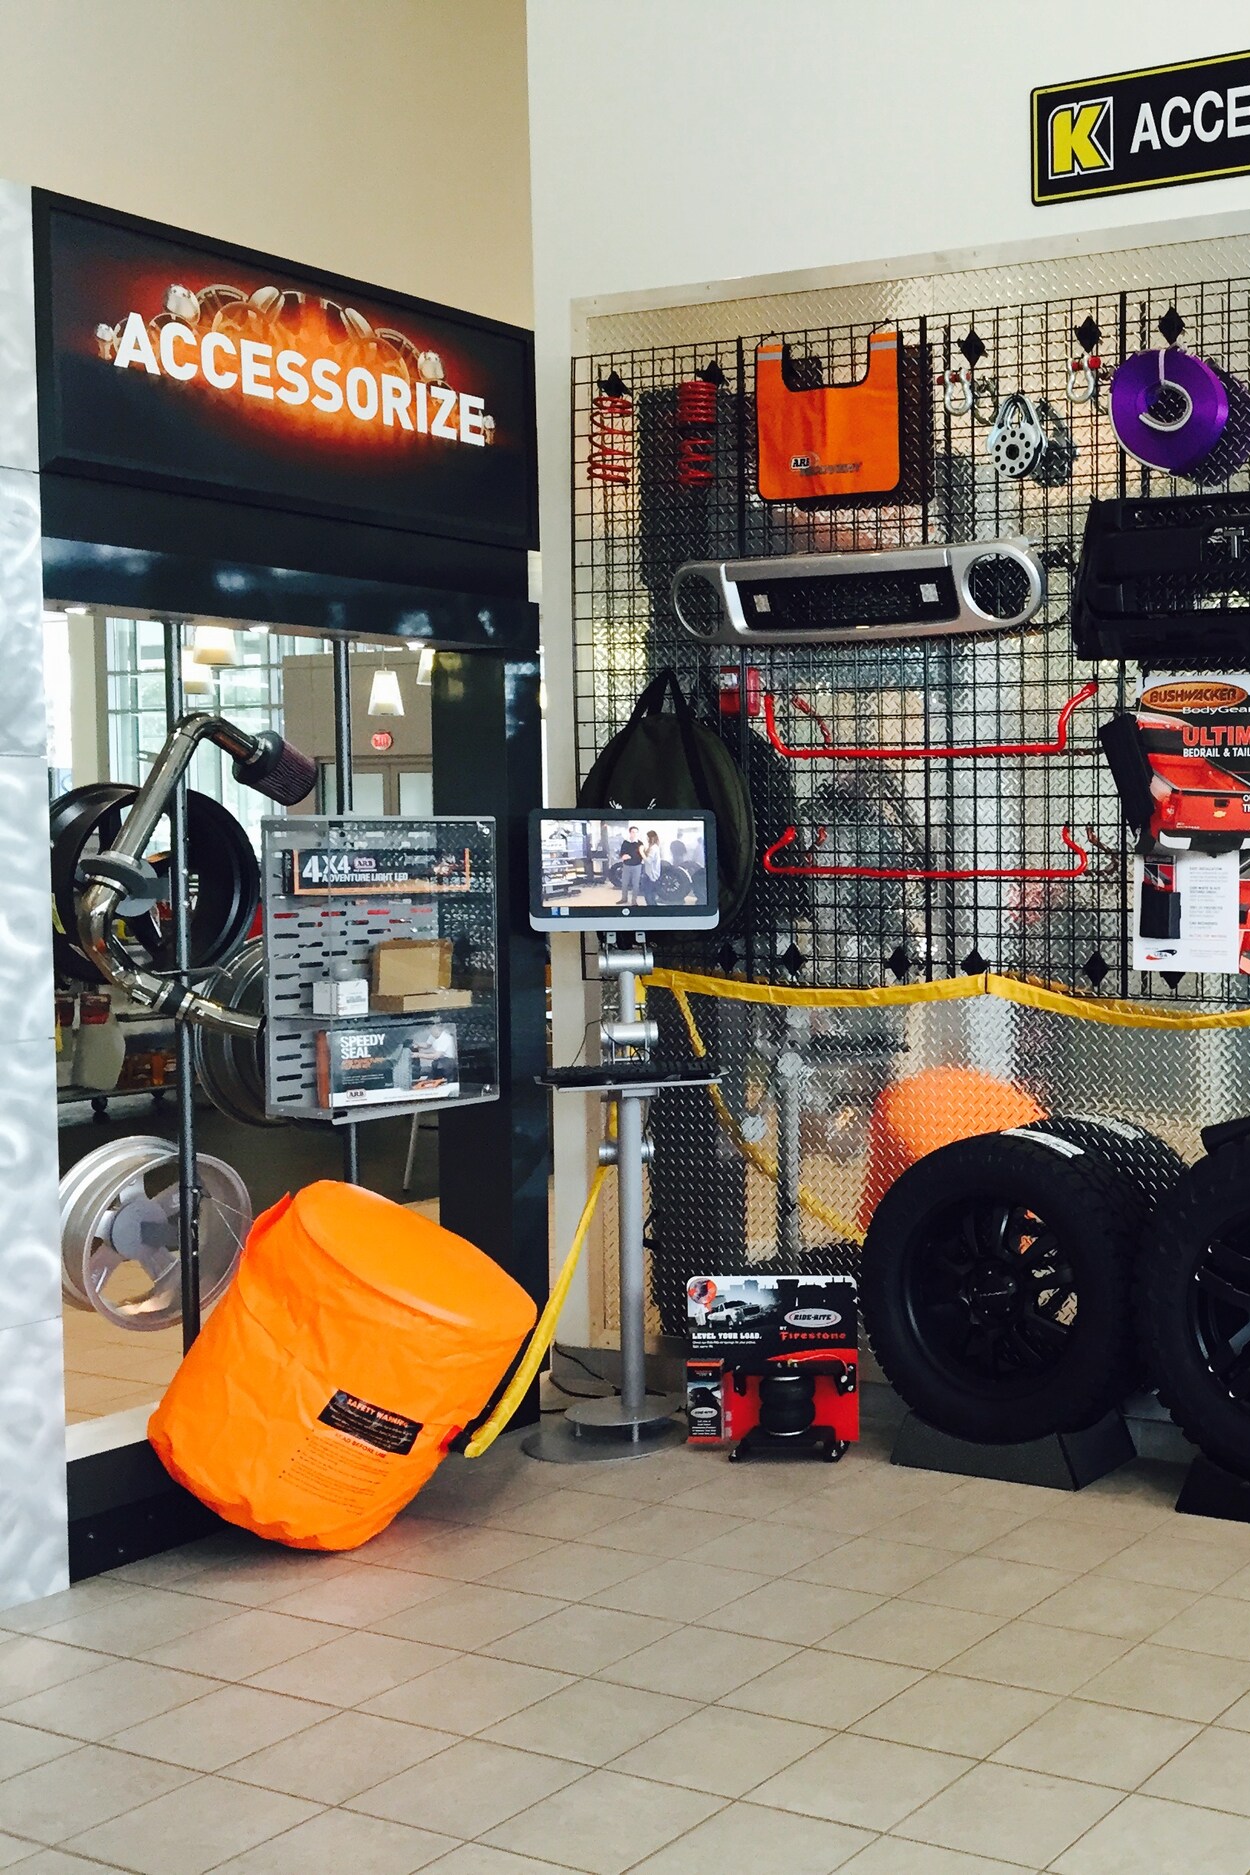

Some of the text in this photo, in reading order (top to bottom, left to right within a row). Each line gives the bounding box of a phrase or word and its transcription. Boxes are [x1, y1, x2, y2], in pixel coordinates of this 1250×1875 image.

[1050, 100, 1110, 176] K
[113, 312, 486, 447] ACCESSORIZE
[1150, 688, 1237, 703] BUSHWACKER
[1183, 748, 1221, 758] BEDRAIL
[1223, 748, 1231, 758] &
[302, 854, 352, 883] 4X4
[322, 872, 409, 883] ADVENTURE LIGHT LED
[340, 1033, 386, 1048] SPEEDY
[341, 1047, 372, 1060] SEAL
[779, 1331, 847, 1341] Firestone
